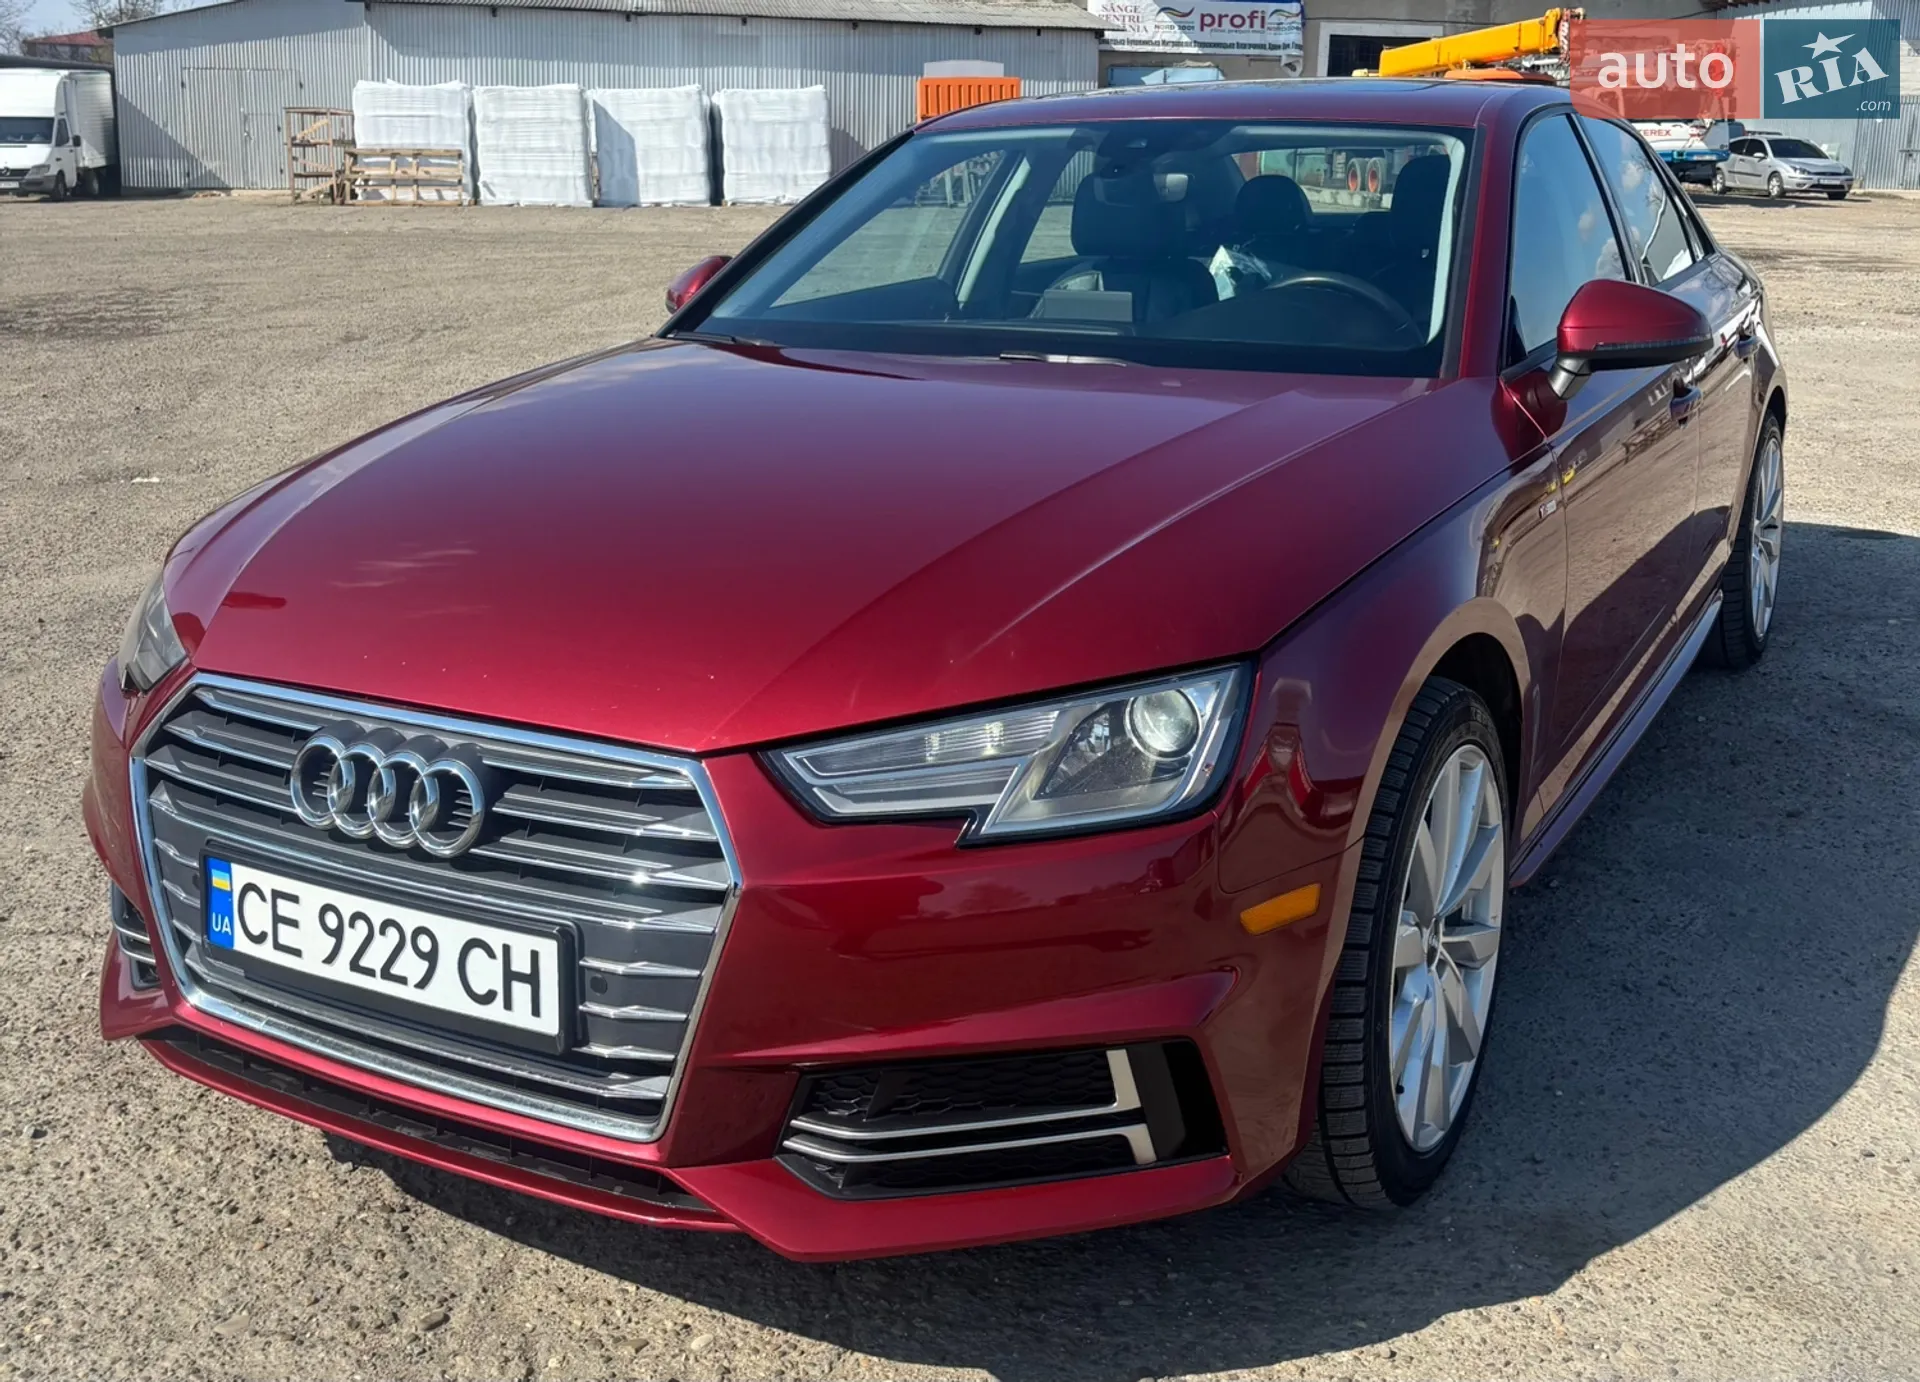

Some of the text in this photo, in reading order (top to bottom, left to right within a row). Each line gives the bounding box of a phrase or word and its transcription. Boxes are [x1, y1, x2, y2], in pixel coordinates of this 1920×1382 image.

[1200, 10, 1265, 32] profi
[212, 913, 232, 936] UA
[237, 882, 541, 1018] CE 9229 CH
